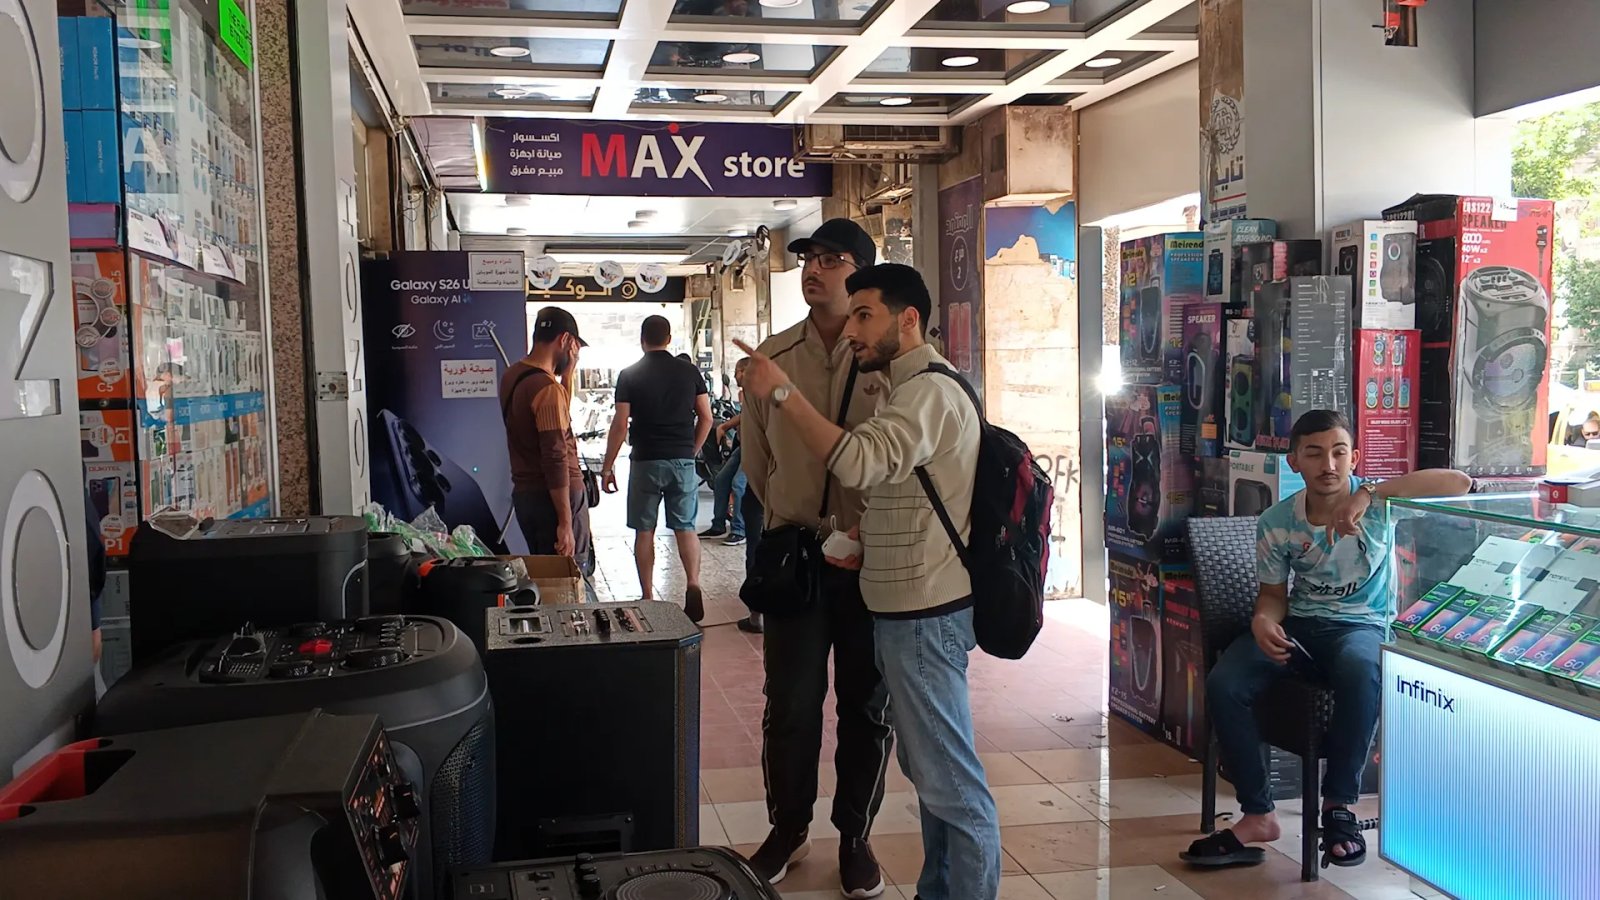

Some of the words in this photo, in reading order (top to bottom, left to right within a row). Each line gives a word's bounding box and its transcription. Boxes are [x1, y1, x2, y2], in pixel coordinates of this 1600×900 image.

[510, 148, 535, 160] اجهزة
[536, 149, 562, 160] صيانة
[580, 123, 713, 191] MAX
[723, 151, 805, 178] store
[510, 165, 536, 176] مفرق
[538, 167, 563, 177] مبيع
[1170, 240, 1204, 249] Meirend
[390, 279, 437, 292] Galaxy
[438, 279, 460, 290] S26
[462, 279, 470, 290] U
[411, 295, 449, 306] Galaxy
[451, 295, 461, 304] AI
[1187, 314, 1216, 324] SPEAKER
[97, 383, 114, 392] C5
[115, 427, 130, 444] P1
[105, 538, 123, 551] P1
[1405, 614, 1422, 623] 60
[1430, 624, 1447, 633] 60
[1454, 631, 1471, 641] 60
[1564, 659, 1584, 670] 60
[1396, 675, 1455, 713] Infinix
